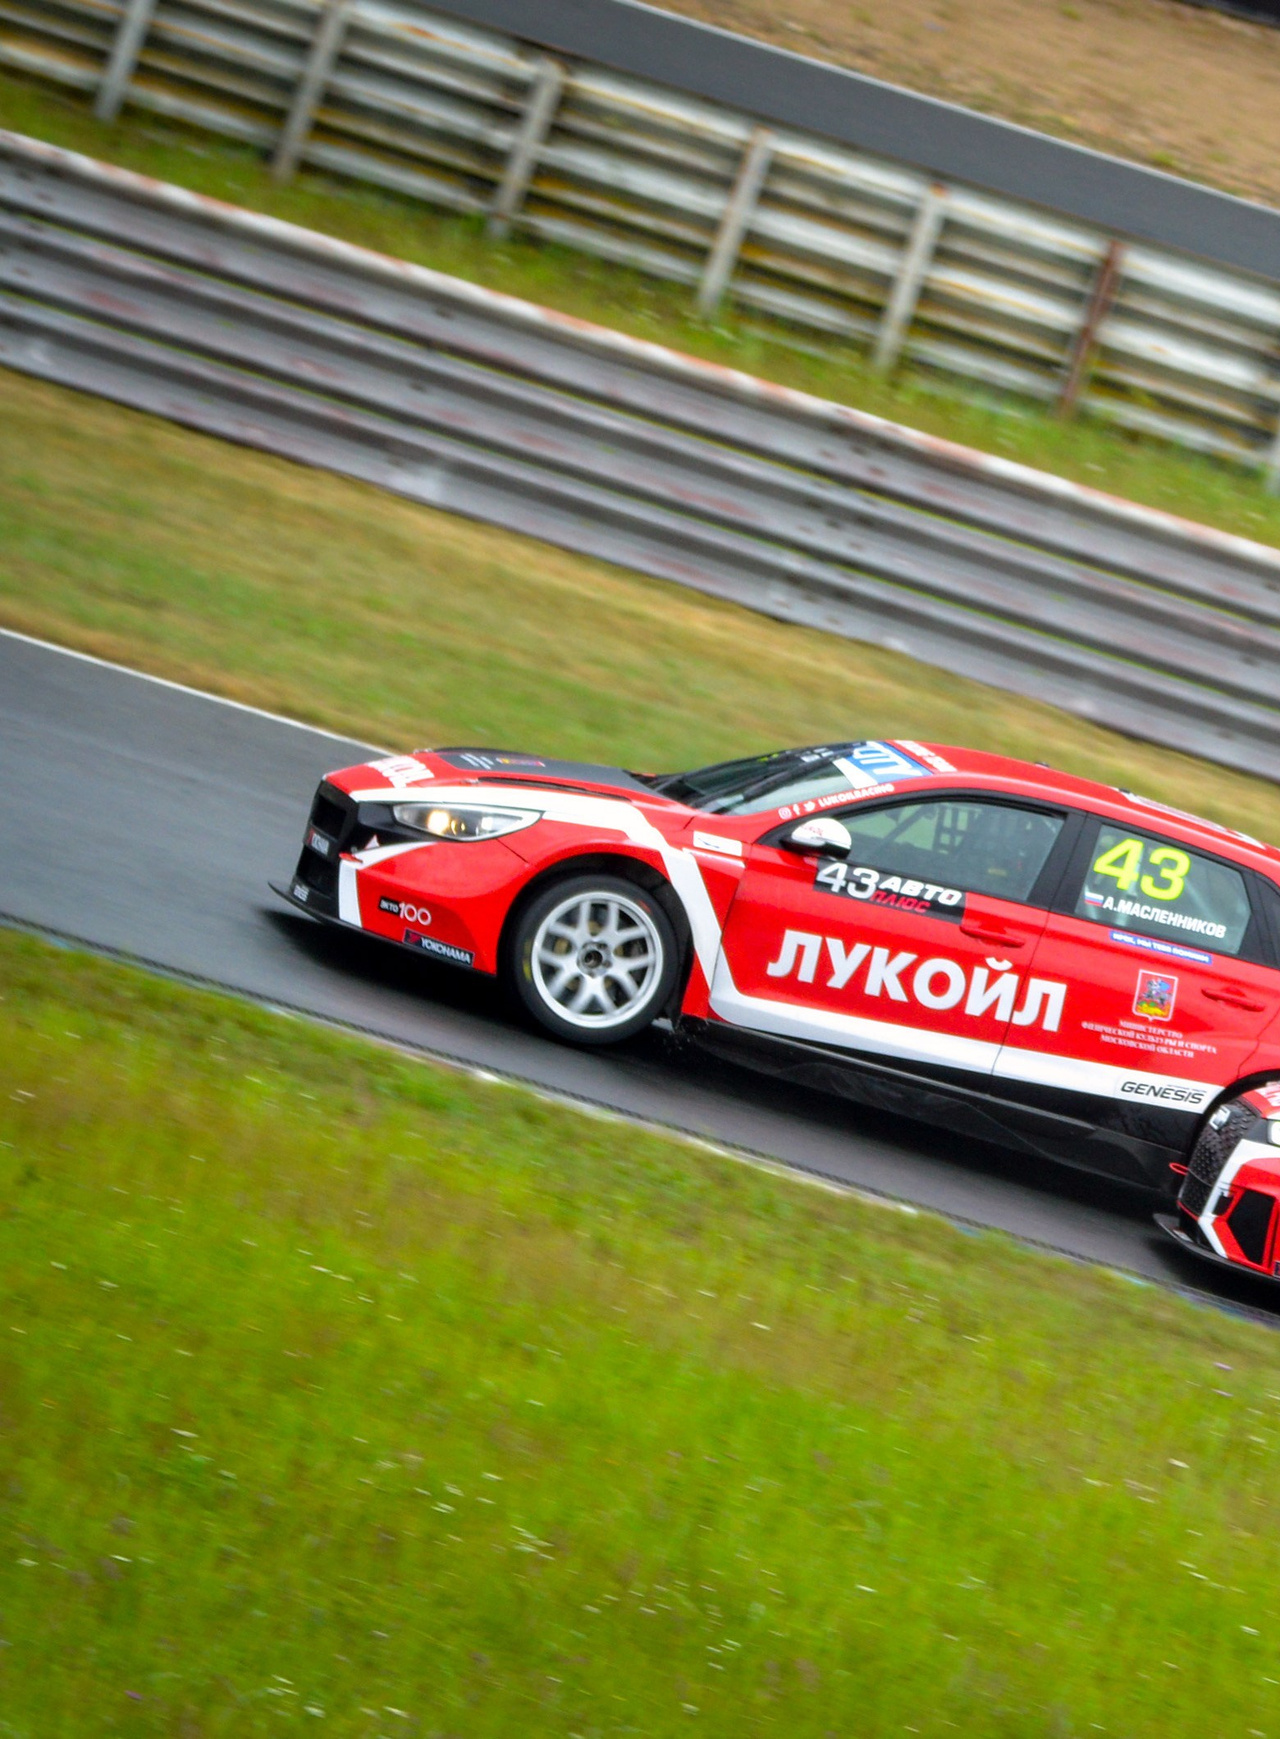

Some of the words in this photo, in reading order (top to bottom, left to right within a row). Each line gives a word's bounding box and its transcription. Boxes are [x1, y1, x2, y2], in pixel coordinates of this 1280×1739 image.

[1093, 838, 1191, 901] 43
[816, 862, 881, 899] 43
[878, 876, 963, 906] АВТО
[399, 901, 432, 926] 100
[870, 891, 931, 913] ПЛЮС
[421, 937, 471, 964] YOKOHAMA
[766, 929, 1068, 1032] ЛУКОЙЛ
[1121, 1081, 1205, 1104] GENESIS
